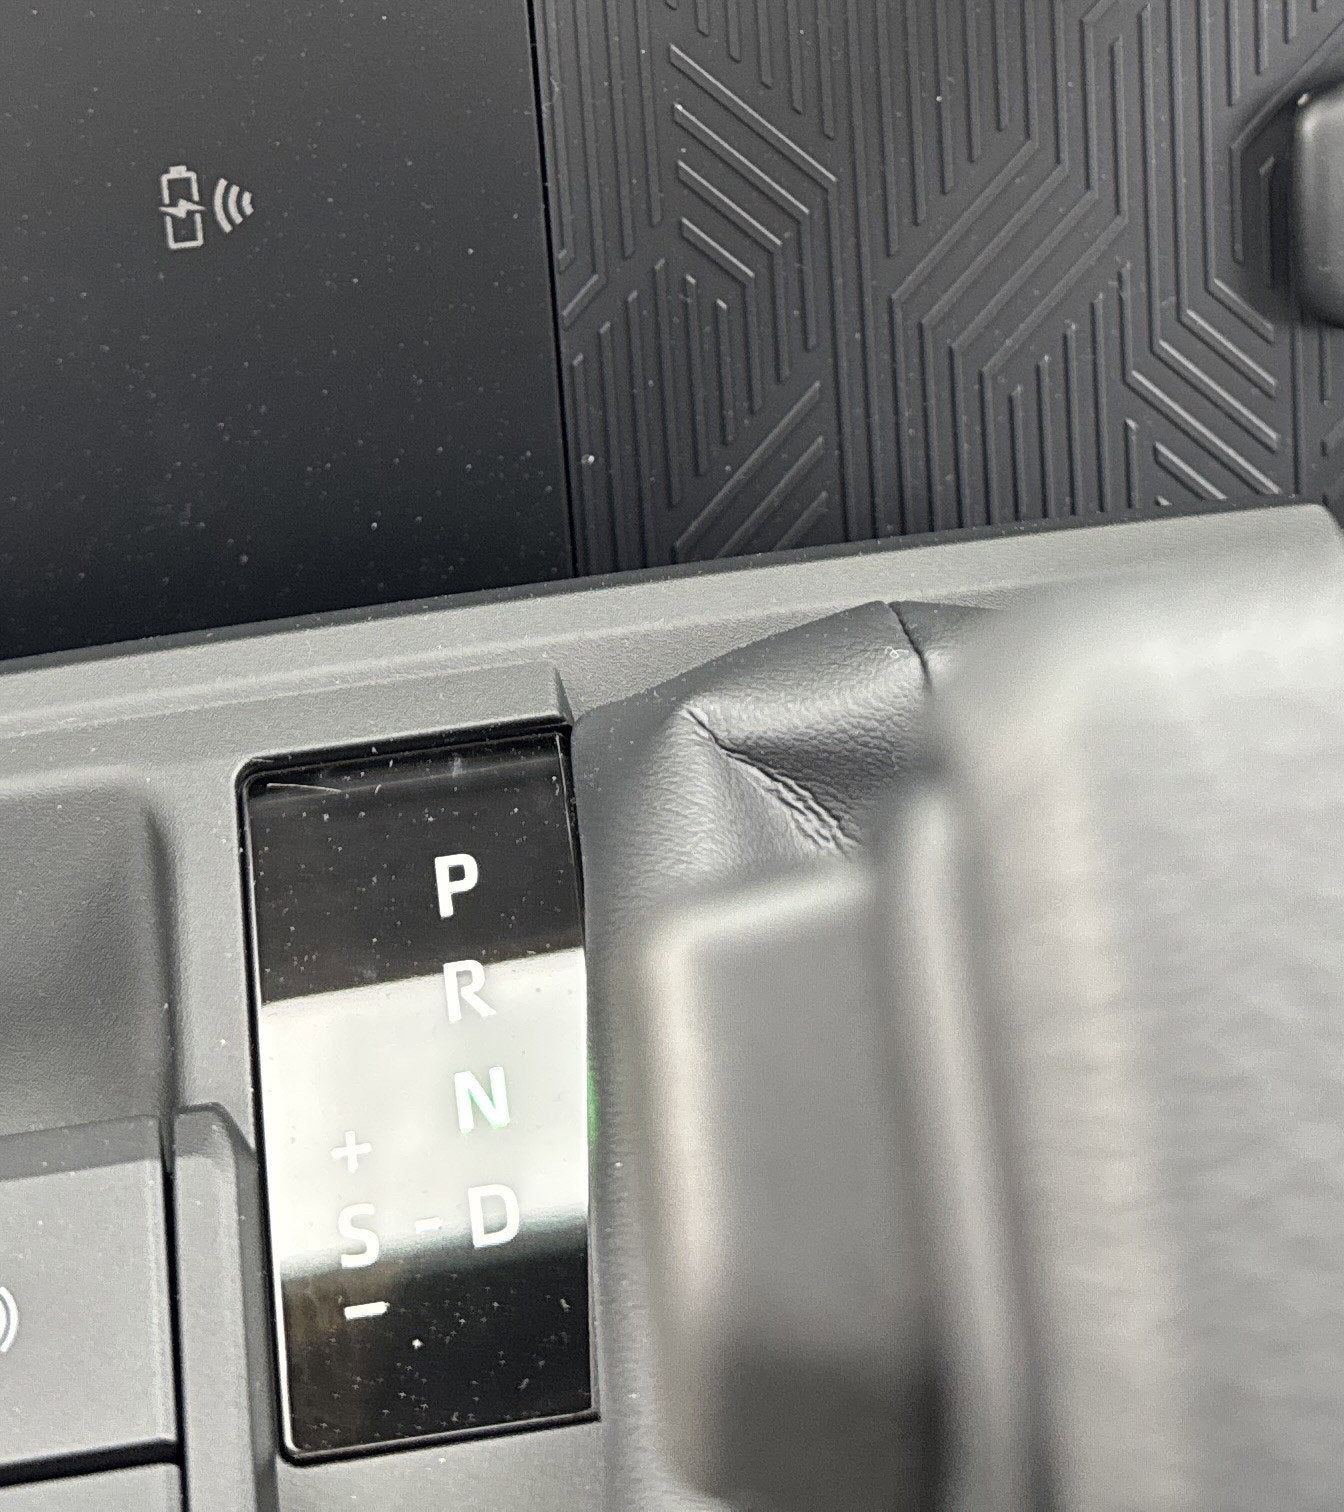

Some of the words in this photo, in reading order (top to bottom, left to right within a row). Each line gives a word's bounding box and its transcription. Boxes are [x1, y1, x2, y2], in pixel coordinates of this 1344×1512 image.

[434, 853, 479, 919] P
[443, 959, 497, 1024] R
[454, 1065, 511, 1135] N
[337, 1202, 380, 1269] S
[467, 1183, 520, 1249] D
